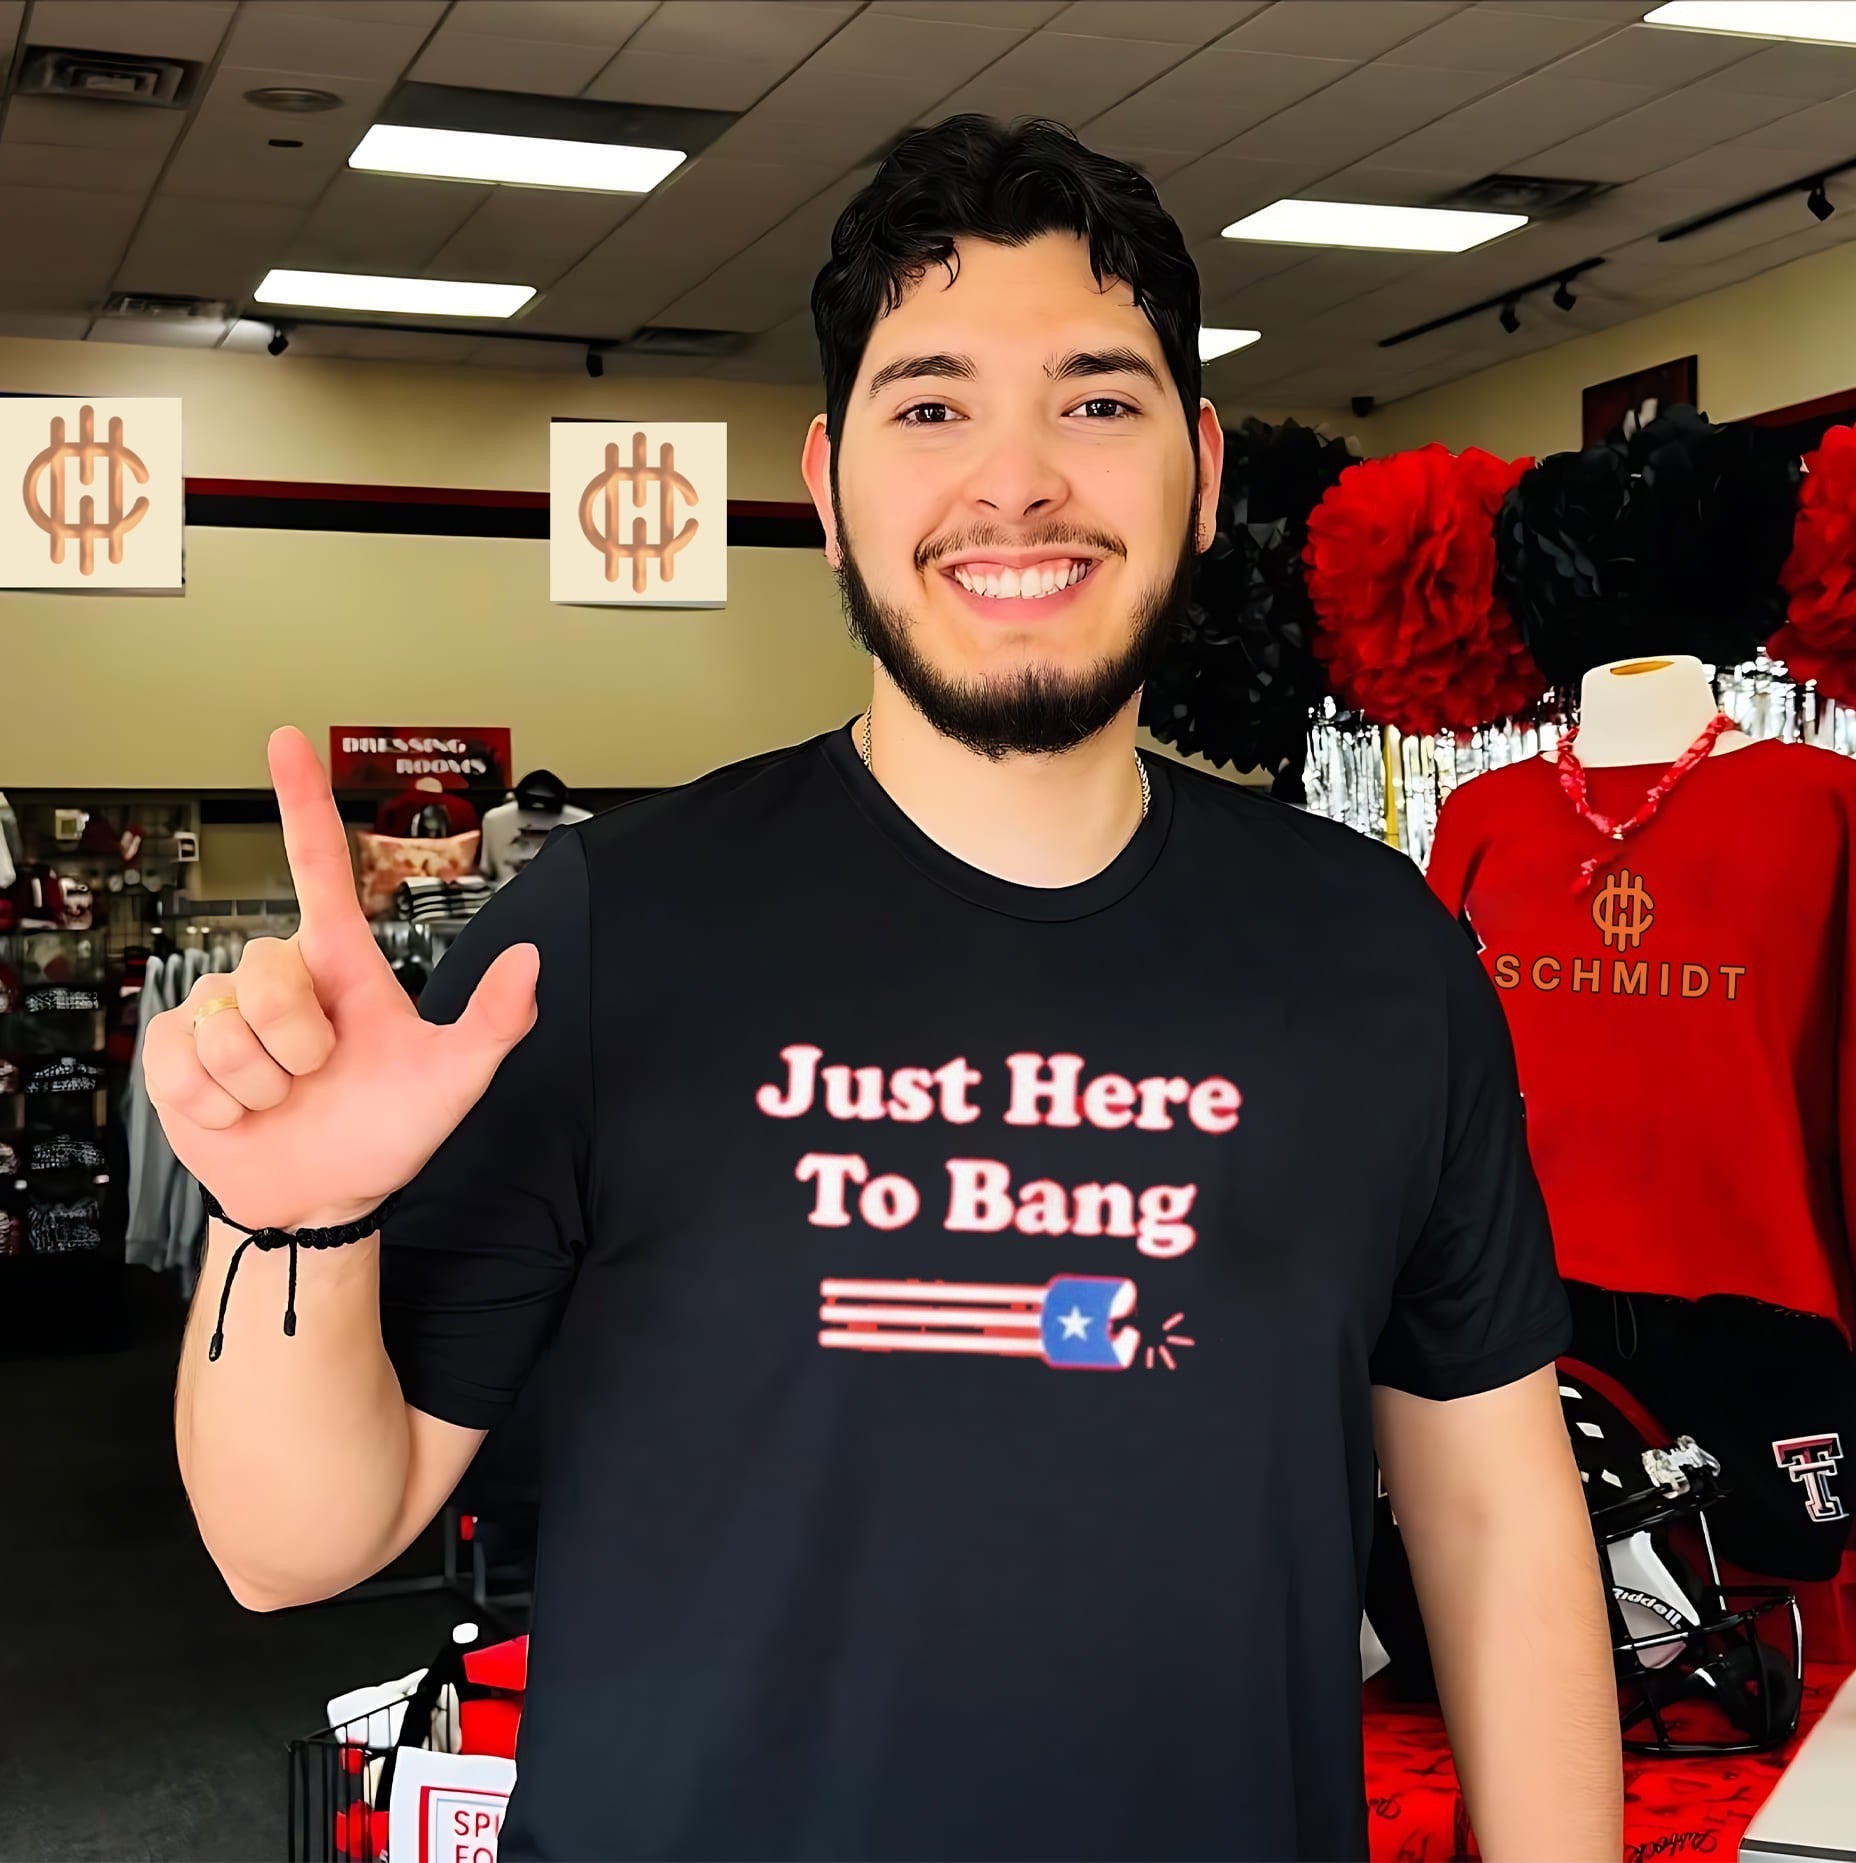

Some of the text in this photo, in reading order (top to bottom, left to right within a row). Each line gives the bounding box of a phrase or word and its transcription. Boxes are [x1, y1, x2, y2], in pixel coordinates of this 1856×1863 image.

[1494, 954, 1747, 1000] SCHMIDT
[755, 1044, 1242, 1134] Just Here
[795, 1152, 1197, 1258] To Bang
